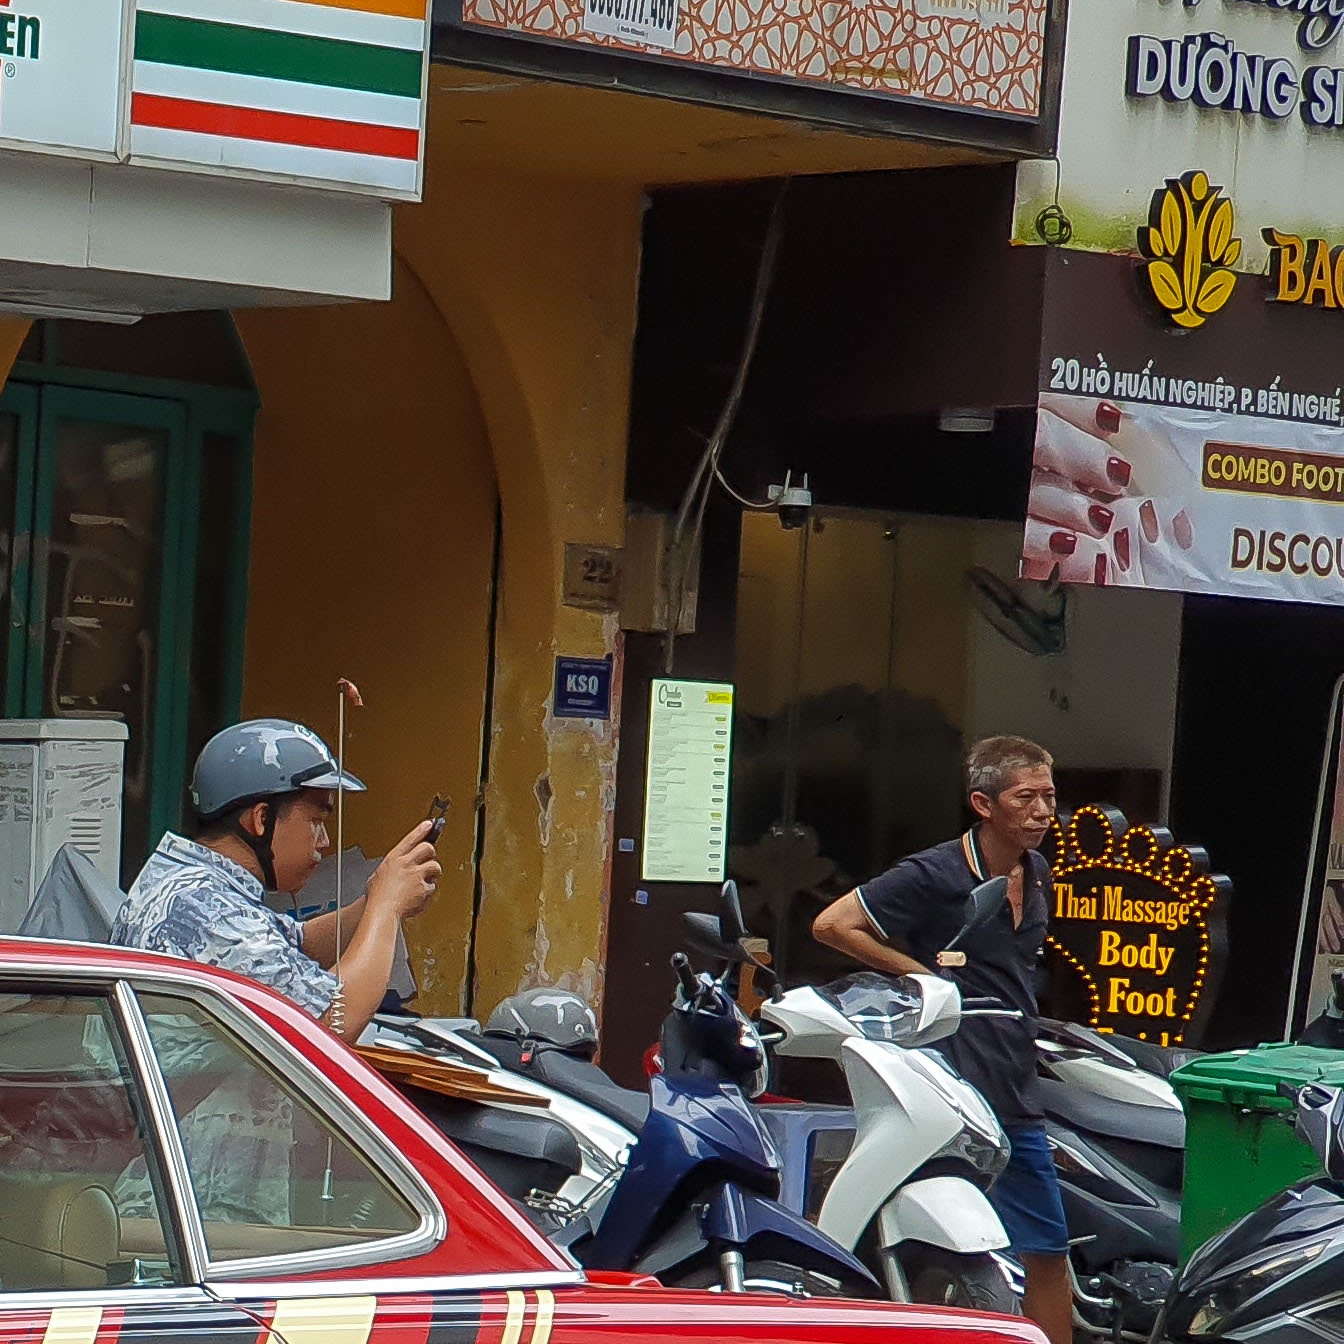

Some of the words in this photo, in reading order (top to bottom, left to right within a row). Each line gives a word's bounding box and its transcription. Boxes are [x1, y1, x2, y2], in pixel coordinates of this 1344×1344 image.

[1130, 33, 1298, 118] DƯỠNG
[1264, 227, 1344, 308] BA
[1050, 358, 1080, 391] 20
[1082, 353, 1111, 395] HỒ
[1114, 360, 1165, 402] HUẤN
[1241, 388, 1256, 412] P.
[1257, 376, 1290, 416] BẾN
[1207, 453, 1287, 486] COMBO
[1053, 883, 1097, 920] Thai
[1102, 886, 1190, 930] Massage
[1098, 931, 1175, 975] Body
[1107, 978, 1177, 1017] Foot
